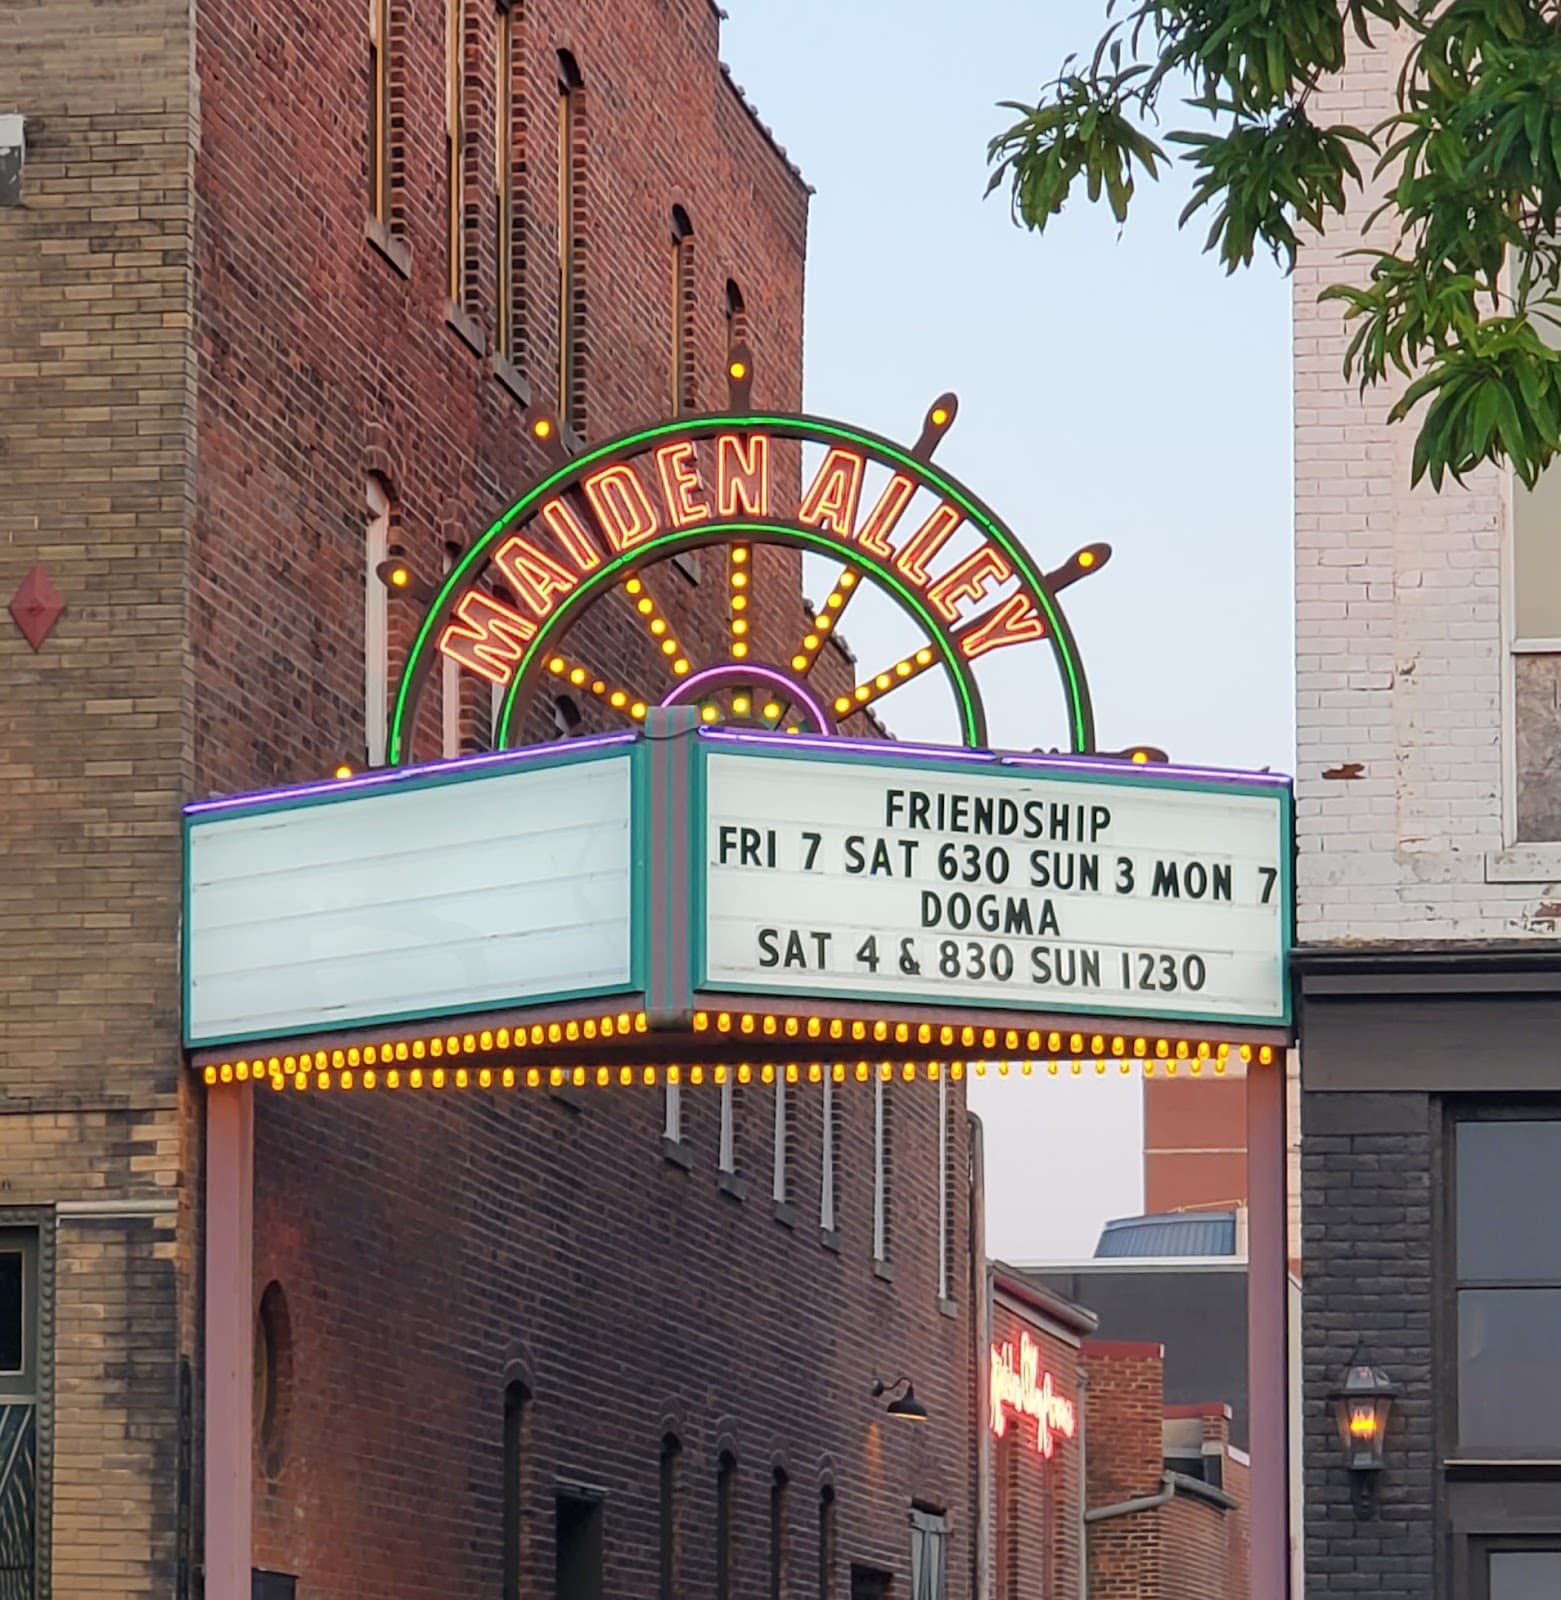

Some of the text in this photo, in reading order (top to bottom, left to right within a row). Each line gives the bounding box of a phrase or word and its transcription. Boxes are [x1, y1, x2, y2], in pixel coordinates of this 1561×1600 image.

[440, 434, 1045, 685] MAIDEN ALLEY
[886, 789, 1111, 843] FRIENDSHIP
[719, 826, 1277, 904] FRI 7 SAT 630 SUN 3 MON 7
[921, 890, 1060, 937] DOGMA
[758, 928, 1206, 992] SAT 4 & 830 SUN 1230
